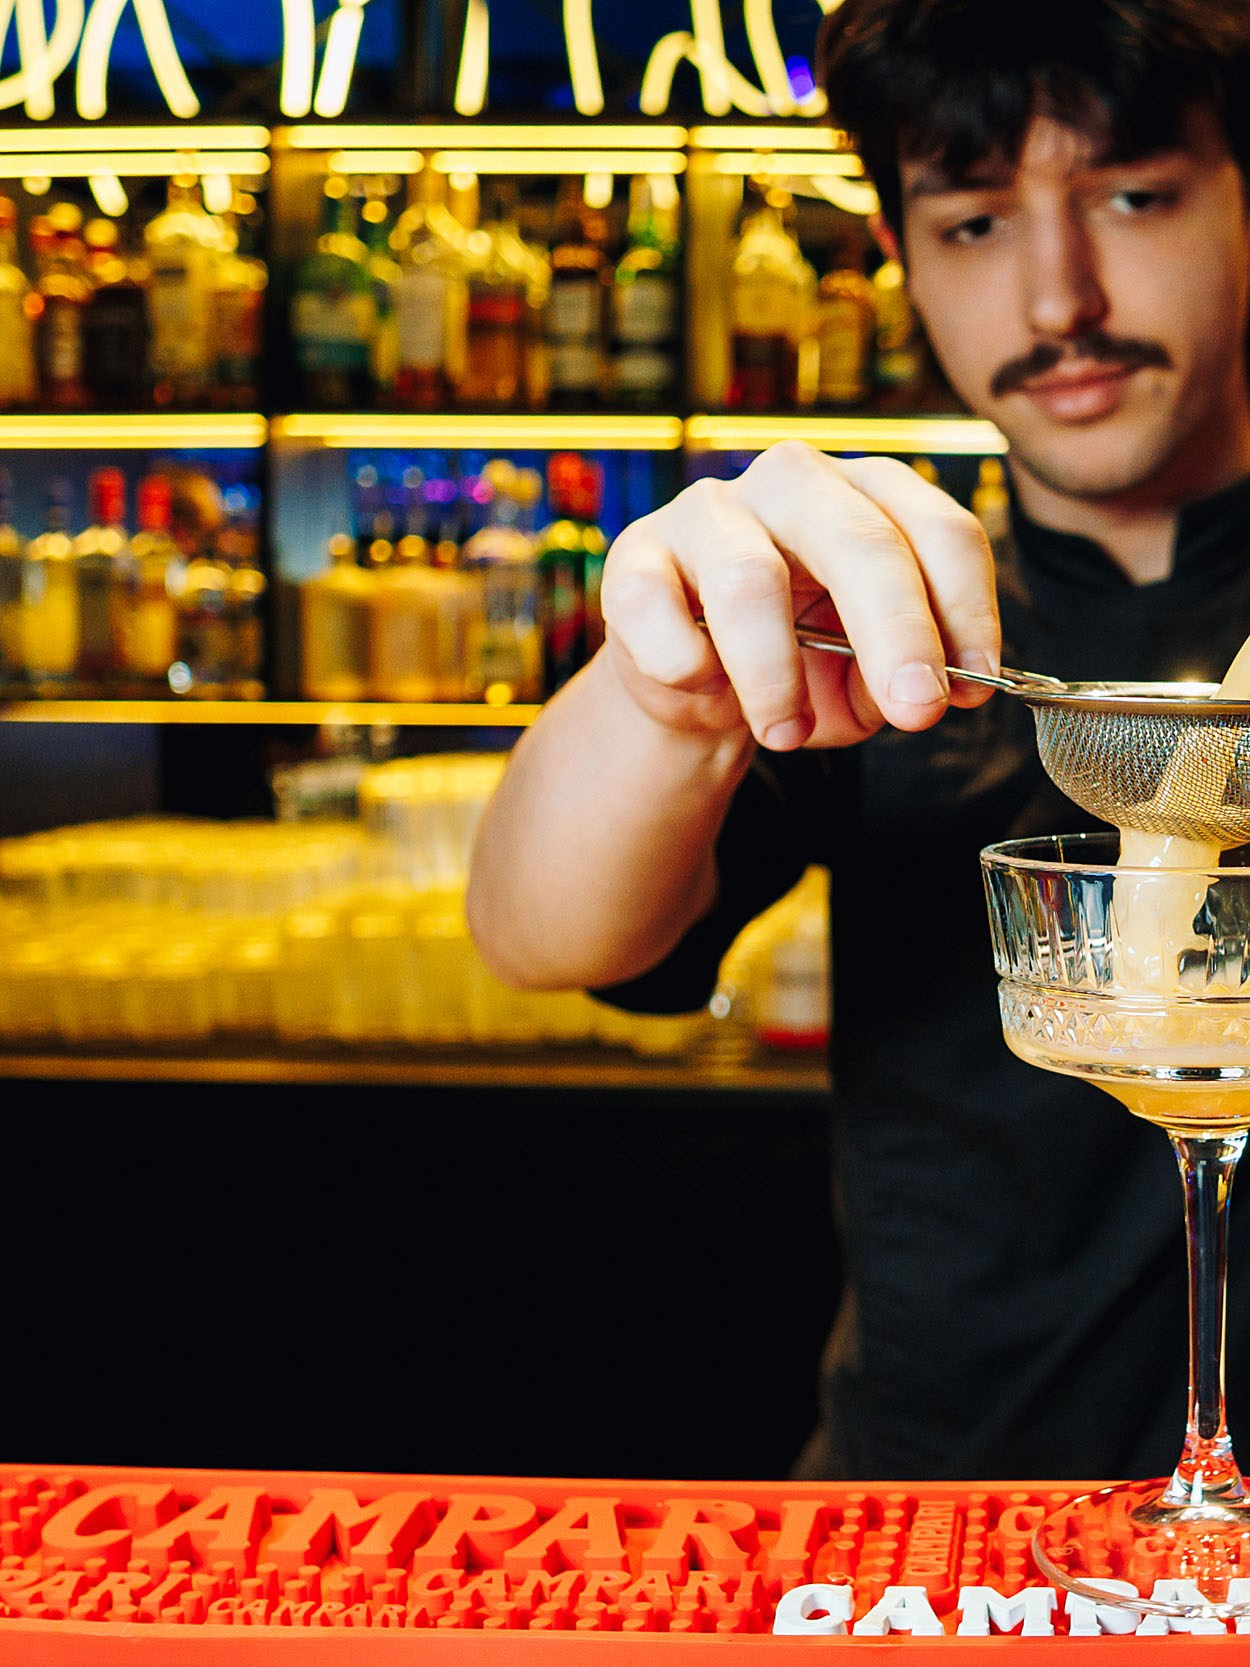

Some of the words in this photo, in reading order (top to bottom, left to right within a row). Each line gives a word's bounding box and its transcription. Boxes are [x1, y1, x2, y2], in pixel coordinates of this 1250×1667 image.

[41, 1483, 828, 1562] CAMPARI
[905, 1500, 955, 1576] CAMPARI
[412, 1569, 762, 1598] CAMPARI
[208, 1597, 428, 1623] CAMPARI
